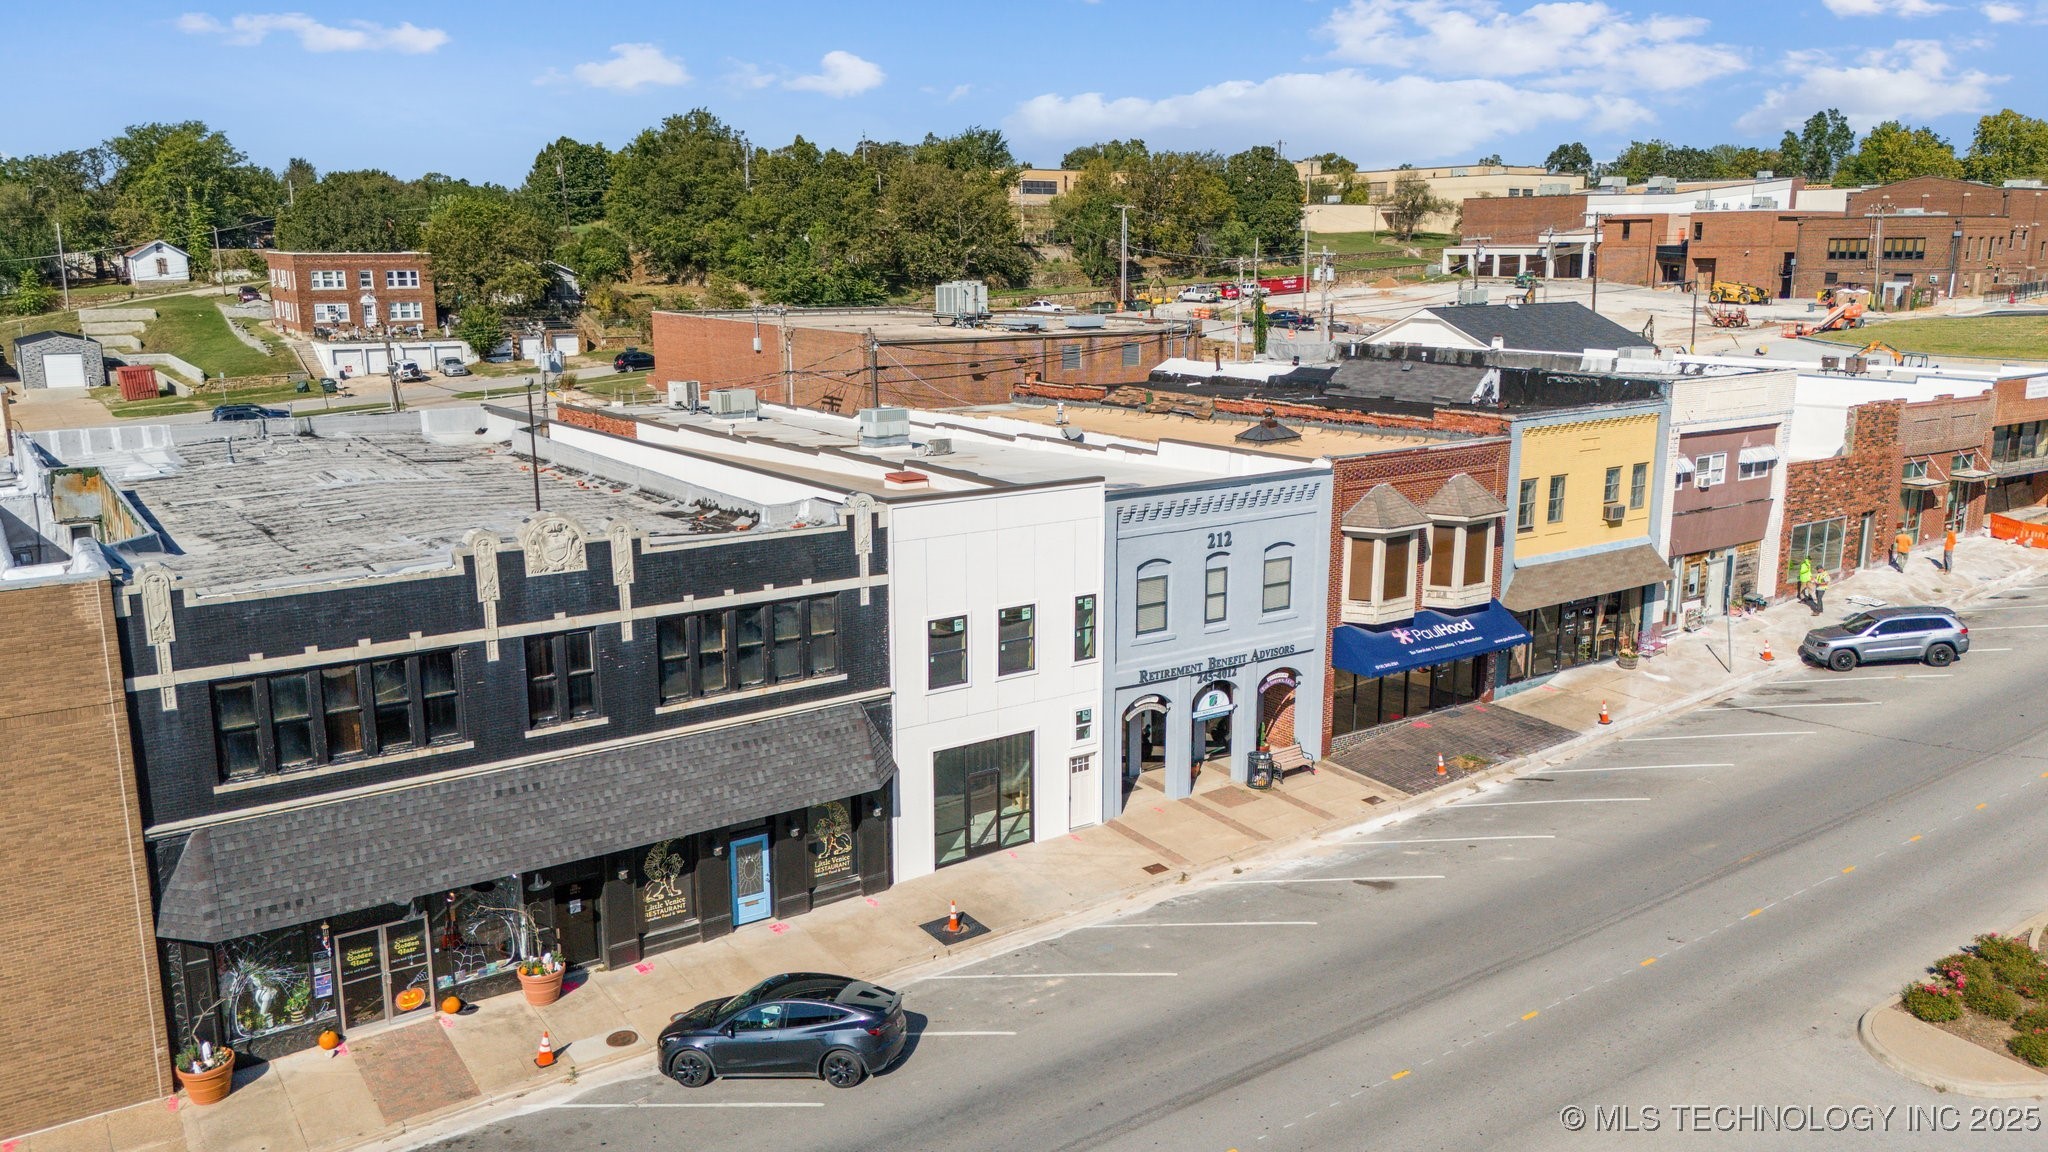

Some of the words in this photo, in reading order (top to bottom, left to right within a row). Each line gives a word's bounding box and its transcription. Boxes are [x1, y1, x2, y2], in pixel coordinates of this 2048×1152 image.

[1207, 531, 1232, 549] 212
[1411, 619, 1475, 641] PaulHood
[1139, 663, 1203, 684] RETIREMENT
[1208, 654, 1248, 670] BENEFIT
[1251, 644, 1295, 662] ADVISORS
[1197, 668, 1238, 684] 245-4012
[814, 860, 850, 873] RESTAURANT
[815, 859, 831, 869] Little
[831, 855, 850, 865] Venice
[644, 903, 686, 918] RESTAURANT
[645, 901, 663, 912] Little
[664, 897, 686, 907] Venice
[394, 940, 420, 950] Golden
[397, 946, 417, 955] Hair
[347, 952, 374, 962] Golden
[351, 958, 371, 967] Hair
